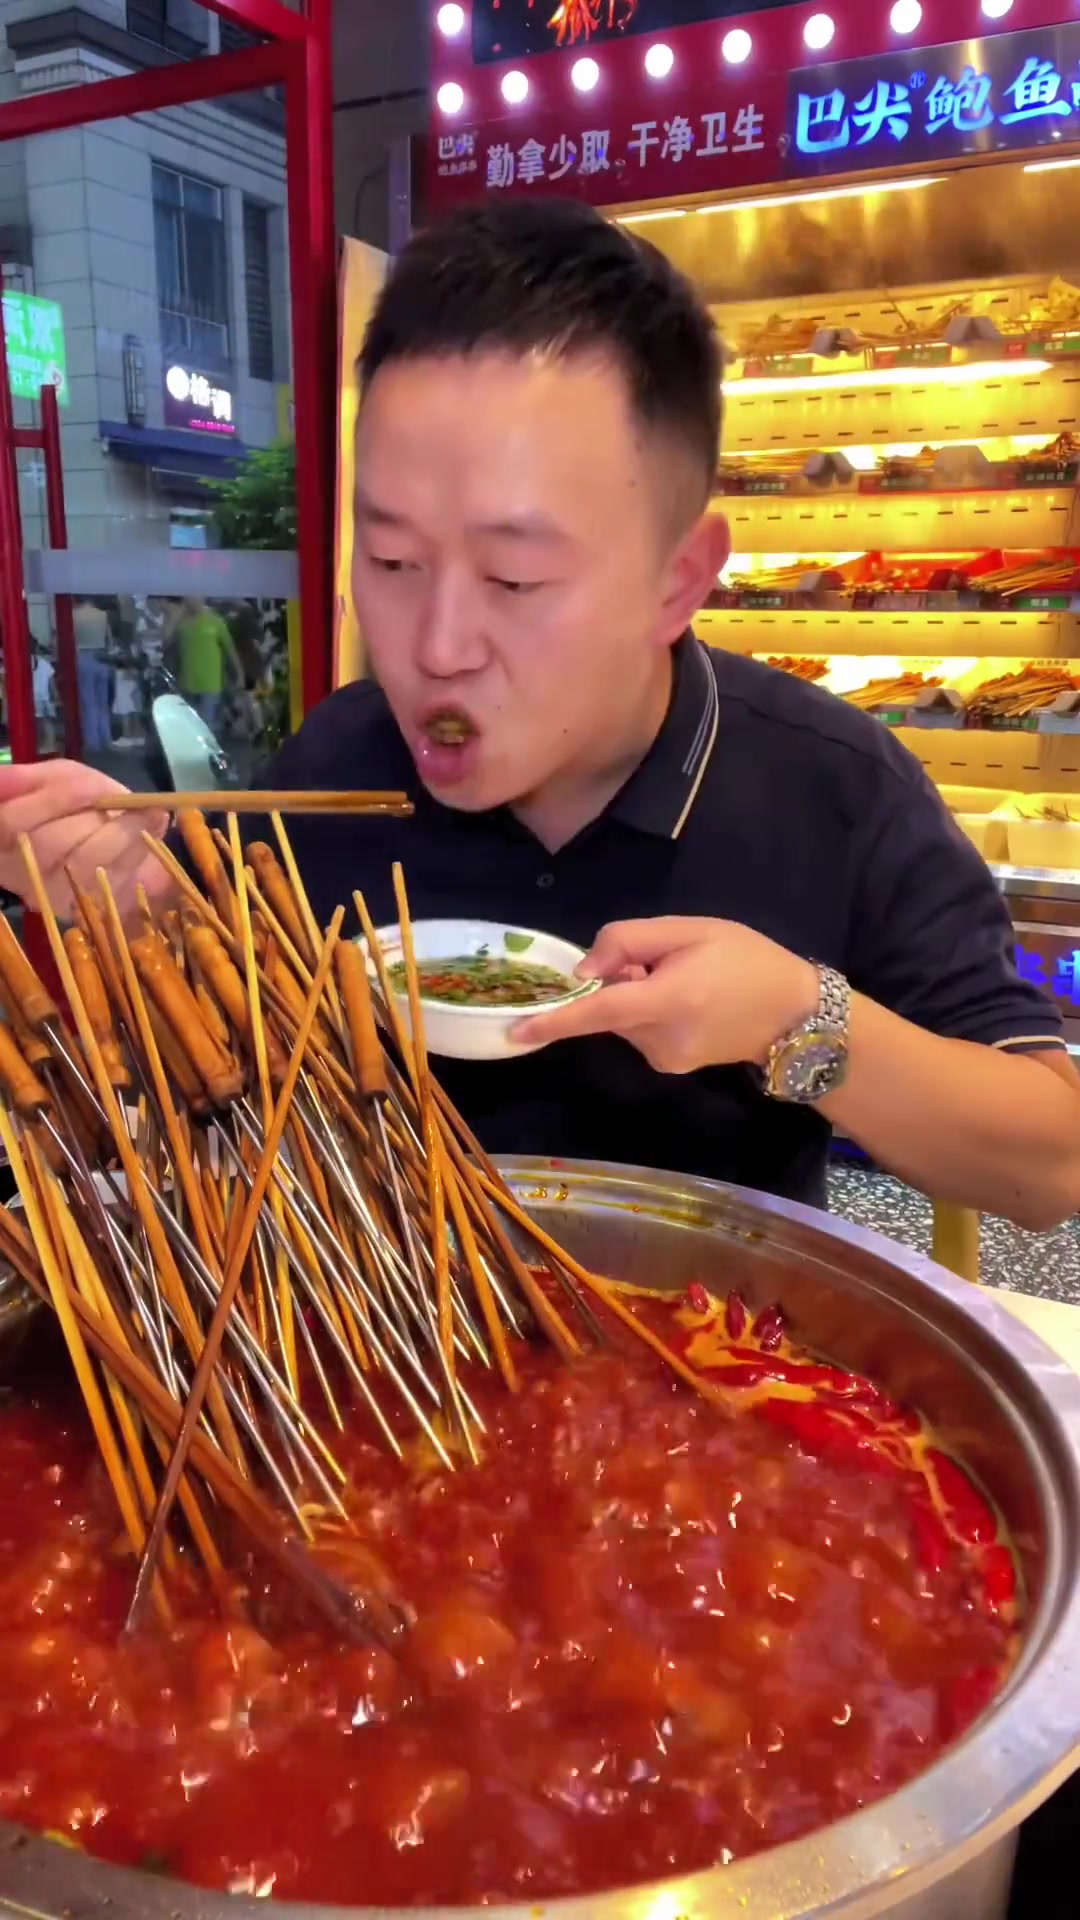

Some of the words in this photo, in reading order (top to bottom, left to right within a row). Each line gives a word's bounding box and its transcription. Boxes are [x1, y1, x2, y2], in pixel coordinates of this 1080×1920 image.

[486, 130, 610, 187] 勤拿少取
[628, 104, 765, 168] 干净卫生
